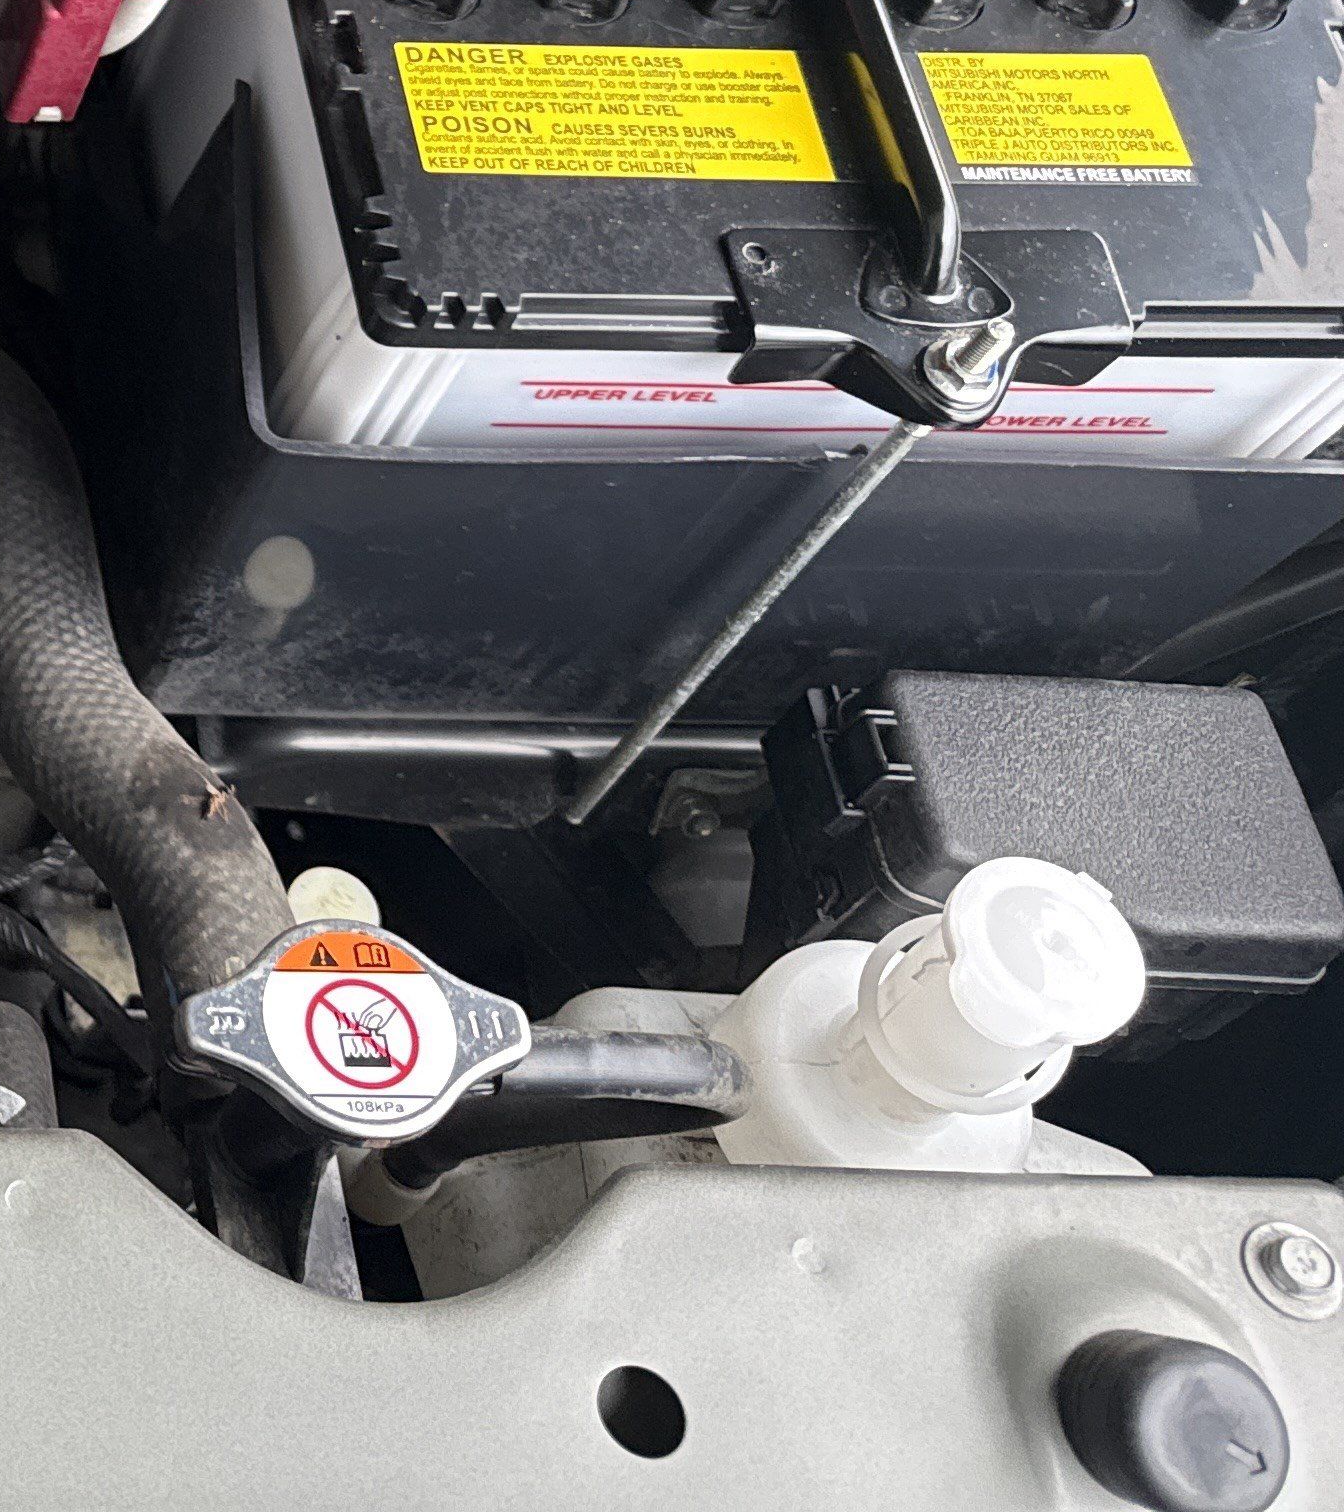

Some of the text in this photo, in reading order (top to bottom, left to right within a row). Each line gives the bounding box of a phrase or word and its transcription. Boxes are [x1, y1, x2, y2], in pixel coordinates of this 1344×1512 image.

[405, 47, 683, 68] DANGER EXPLOSIVE GASES
[966, 57, 985, 68] BY
[926, 68, 1110, 80] MITSUBISHI MOTORS NORTH
[1017, 92, 1034, 103] TN
[414, 99, 683, 117] KEEP VENT CAPS TIGHT AND LEVEL
[939, 103, 1132, 115] MITSUBISHI MOTOR SALES OF
[422, 115, 533, 134] POISON
[551, 122, 613, 136] CAUSES
[682, 126, 737, 139] BURNS
[944, 115, 1020, 126] CARIBBEAN
[958, 127, 986, 137] TOA
[1081, 128, 1115, 139] RICO
[952, 138, 998, 150] TRIPLE
[1012, 139, 1048, 151] AUTO
[1050, 140, 1149, 152] DISTRIBUTORS
[427, 156, 696, 174] KEEP OUT OF REACH OF CHILDREN
[961, 167, 1192, 183] MAINTENANCE FREE BATTERY
[533, 388, 718, 404] UPPER LEVEL
[985, 414, 1154, 429] OWER LEVEL
[346, 1099, 405, 1115] 108kPa
